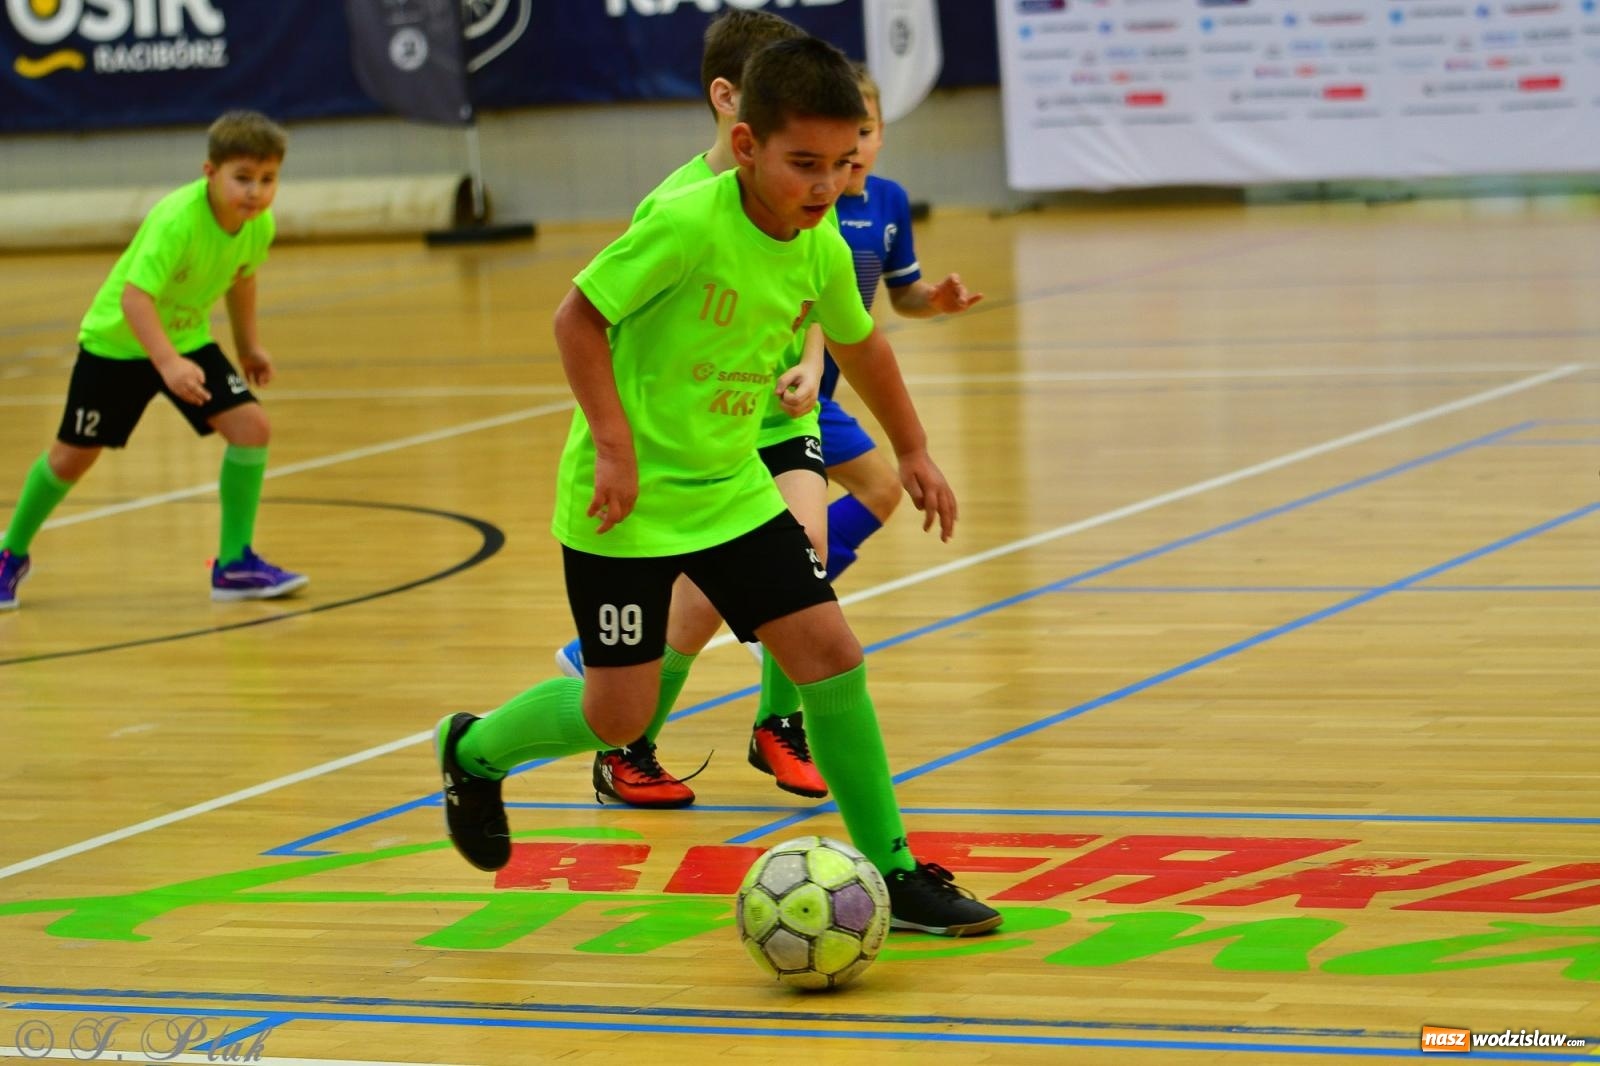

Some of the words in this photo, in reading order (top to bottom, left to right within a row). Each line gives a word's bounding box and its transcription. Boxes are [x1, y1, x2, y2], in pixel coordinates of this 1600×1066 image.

[93, 35, 229, 73] RACIBÓRZ
[698, 281, 738, 327] 10
[75, 407, 100, 436] 12
[599, 603, 642, 646] 99
